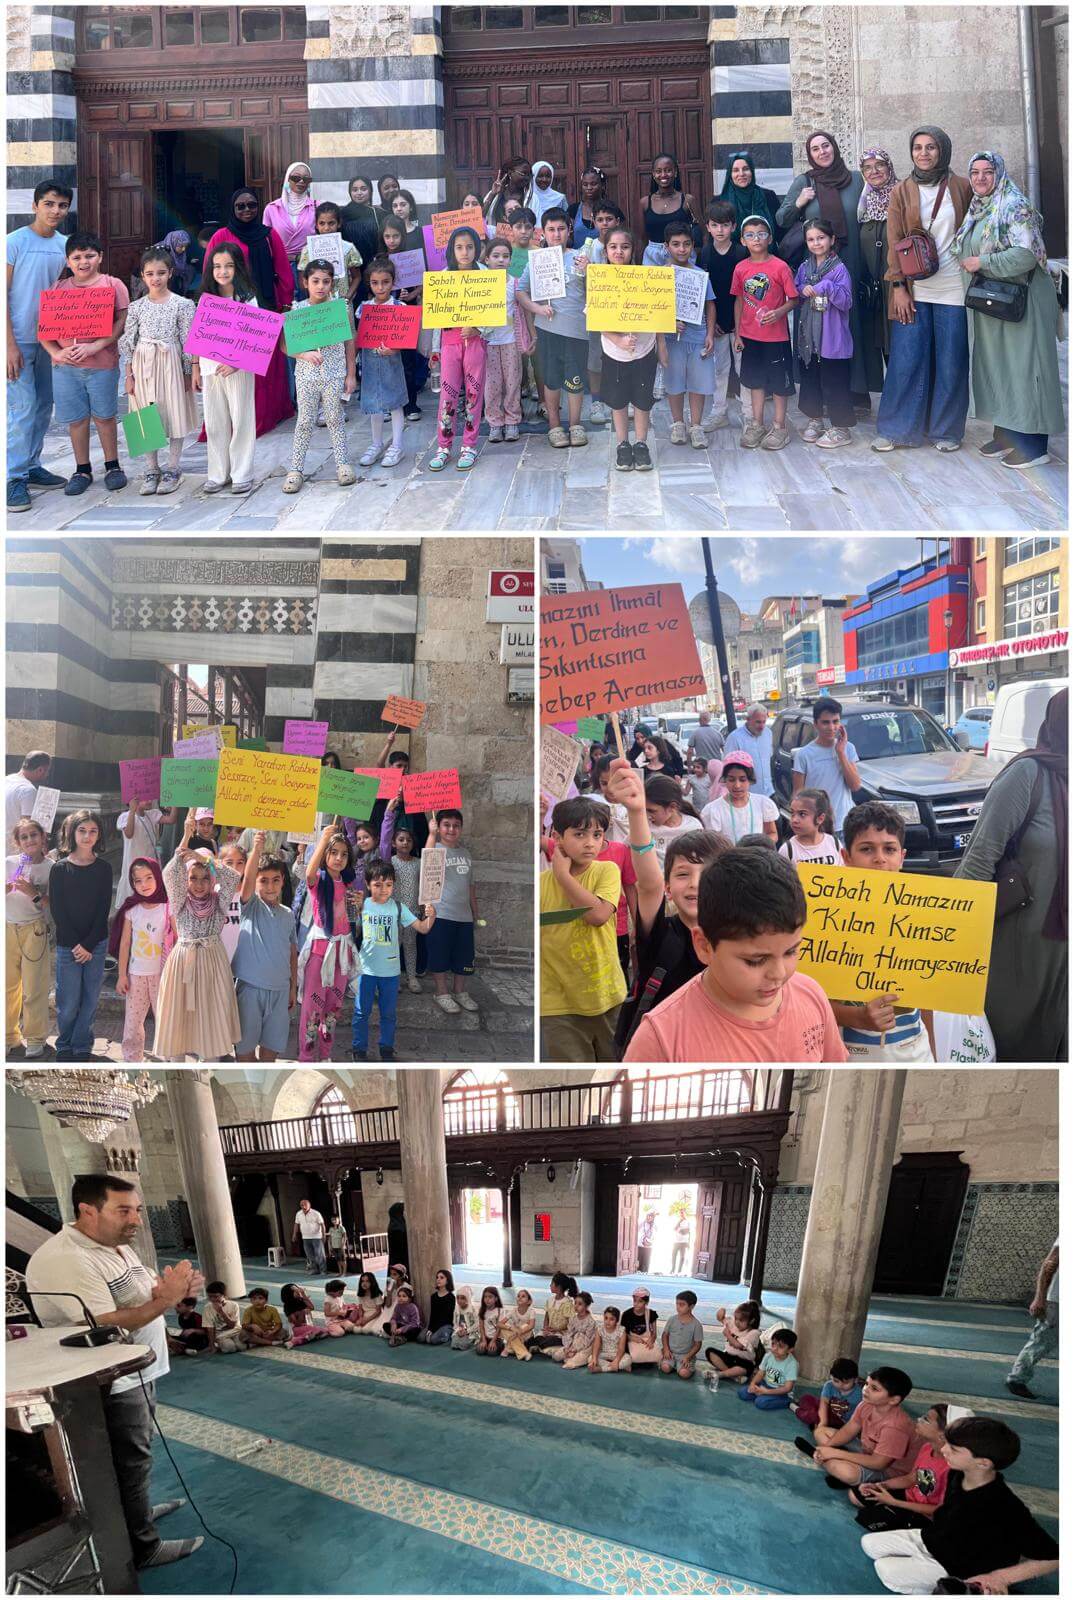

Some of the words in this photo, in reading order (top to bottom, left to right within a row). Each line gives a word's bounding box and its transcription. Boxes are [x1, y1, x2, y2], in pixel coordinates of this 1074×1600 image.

[428, 275, 455, 286] Sabah
[461, 274, 498, 285] Namazını
[614, 267, 644, 279] Yaratan
[432, 288, 459, 299] Kılan
[200, 312, 232, 328] Uyanma
[571, 621, 650, 647] Derdine
[655, 619, 679, 631] ve
[1011, 630, 1069, 654] OTOMOTİV
[253, 754, 286, 771] Yaratan
[808, 875, 871, 902] Sabah
[883, 883, 974, 912] Namazını
[368, 916, 393, 925] NEVER
[812, 908, 875, 935] Kılan
[889, 914, 957, 942] Kimse
